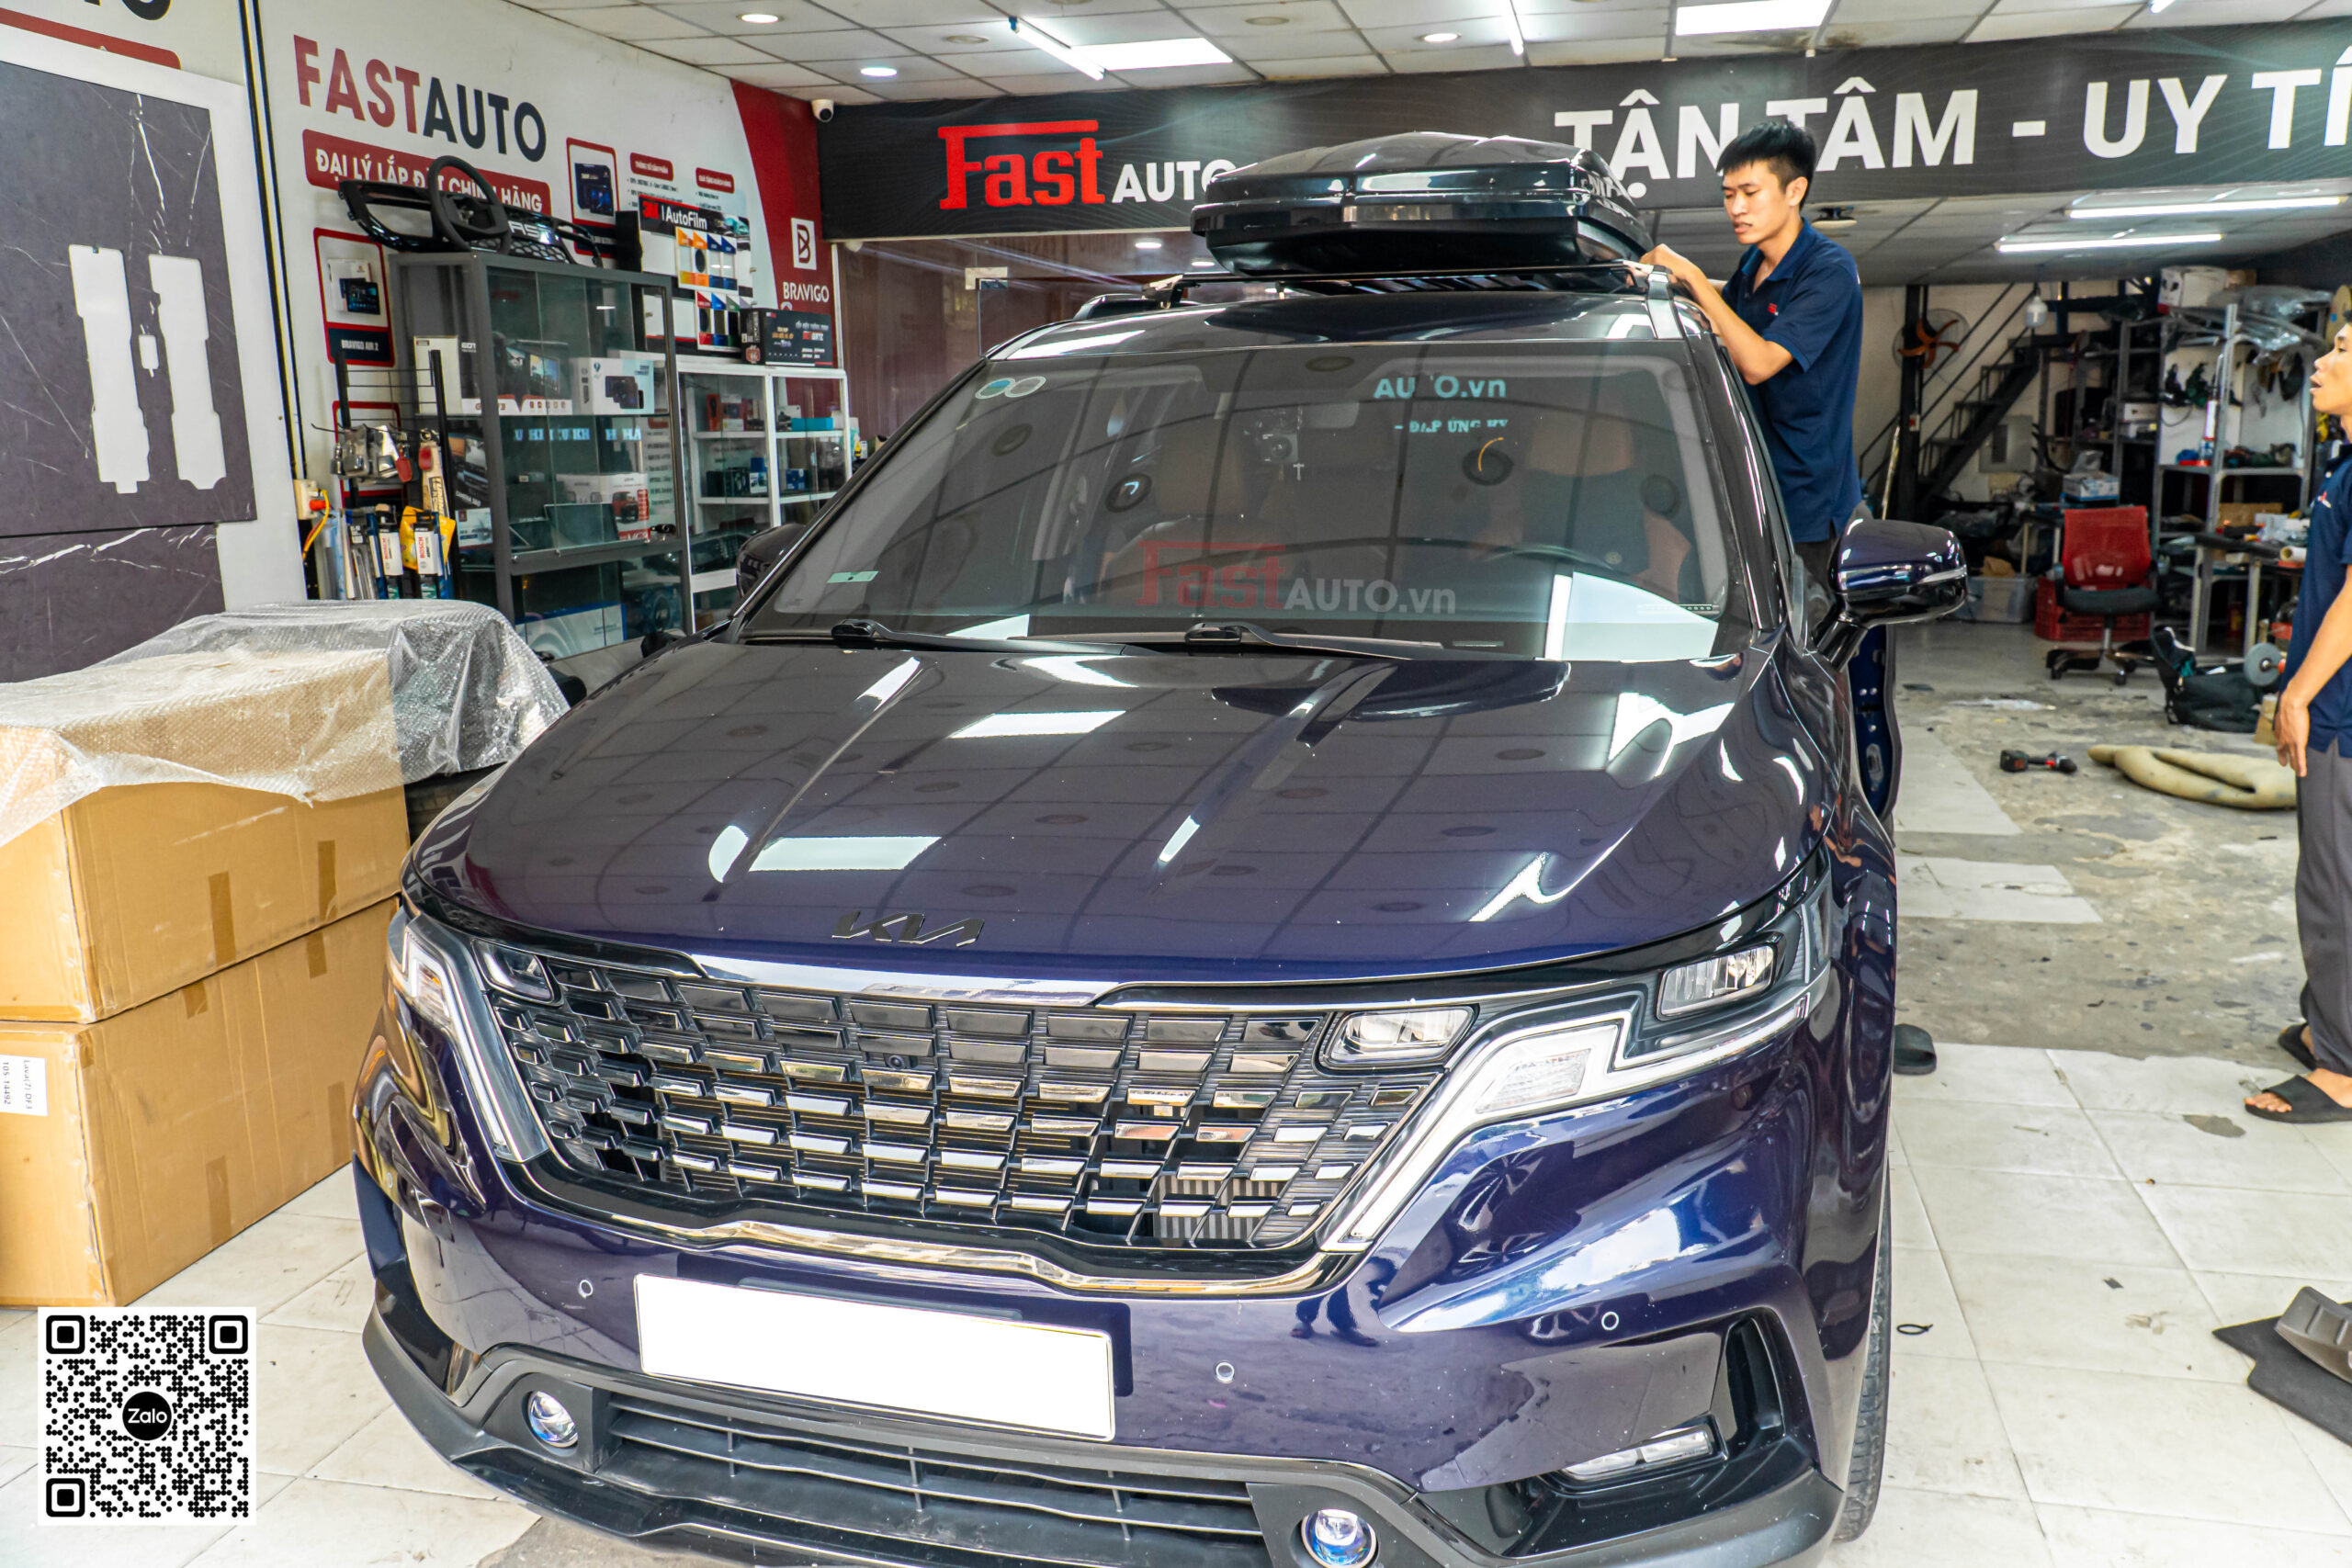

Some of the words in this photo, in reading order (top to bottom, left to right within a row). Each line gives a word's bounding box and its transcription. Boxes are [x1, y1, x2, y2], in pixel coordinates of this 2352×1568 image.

[293, 35, 547, 162] FASTAUTO
[1555, 88, 1739, 198] TẬN
[1766, 77, 1979, 172] TÂM
[2083, 74, 2228, 158] UY
[316, 148, 347, 182] ĐẠI
[353, 153, 372, 182] LÝ
[938, 119, 1105, 209] Fast
[642, 200, 659, 220] 3M
[666, 206, 707, 230] AutoFilm
[783, 281, 829, 302] BRAVIGO
[1374, 375, 1507, 399] AUO.vn
[1136, 540, 1286, 610] Fast
[1285, 578, 1456, 614] AUTO.vn
